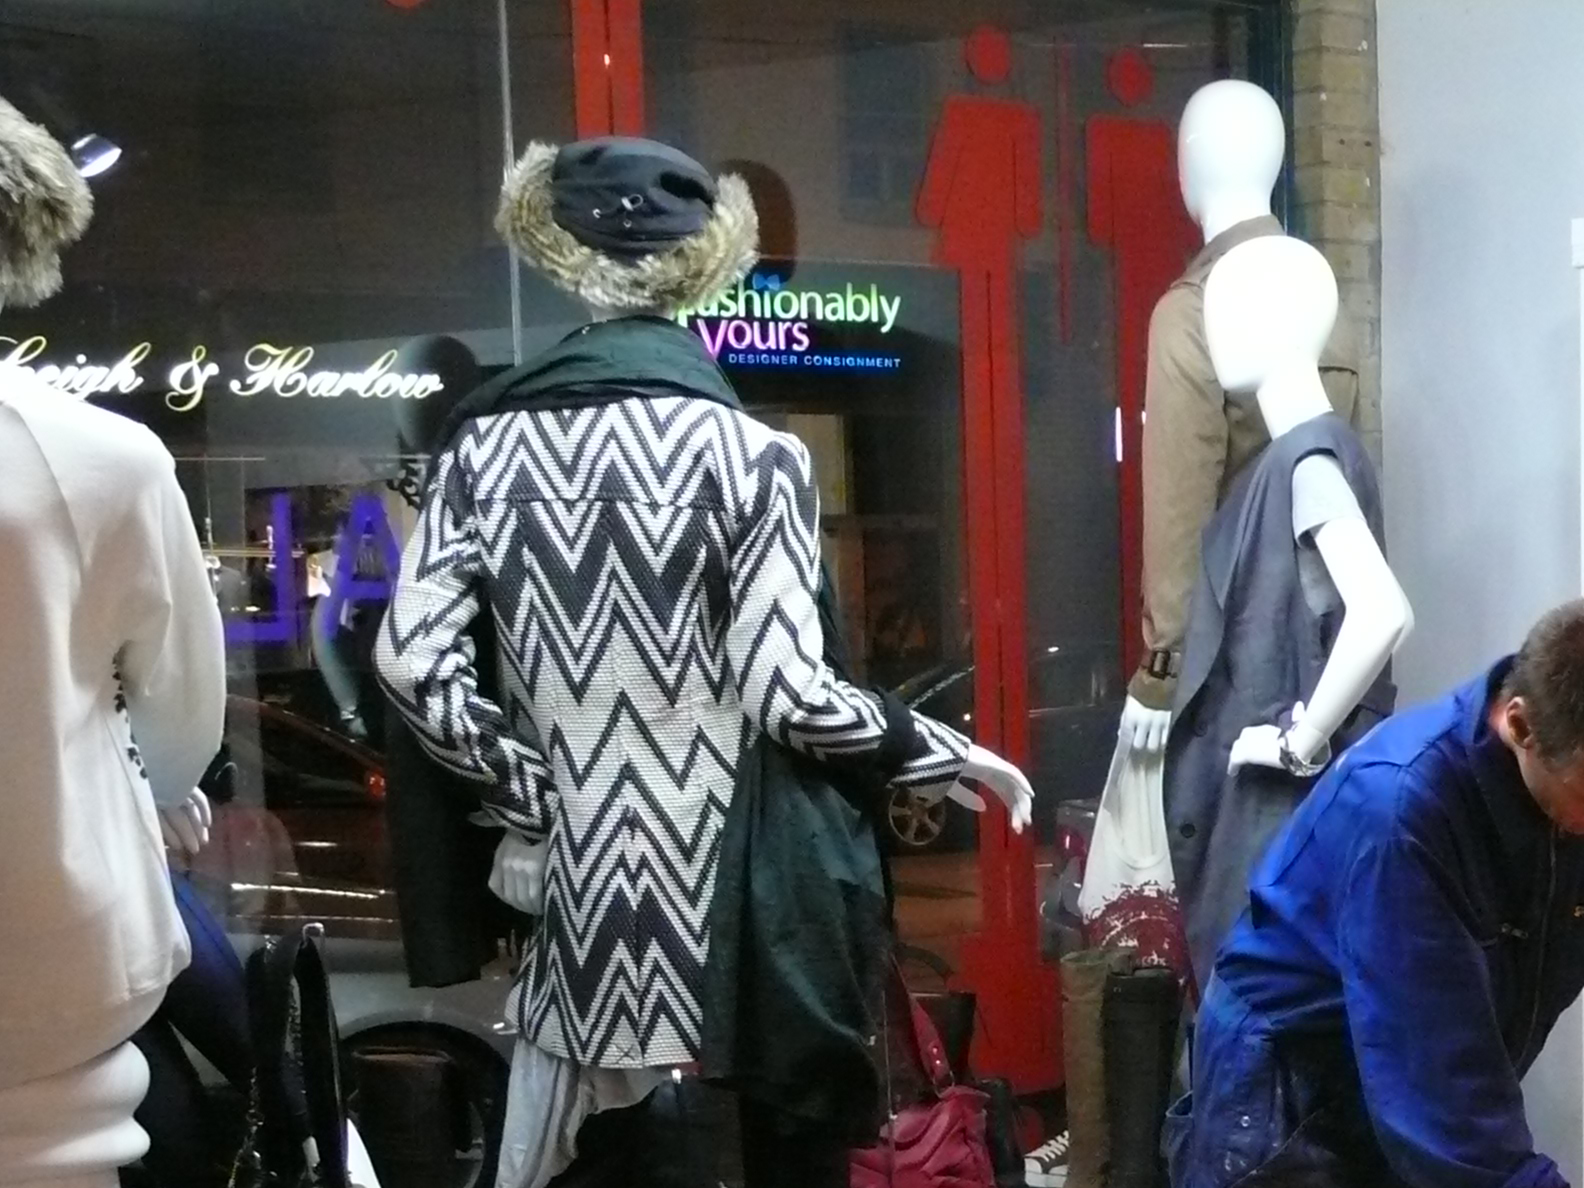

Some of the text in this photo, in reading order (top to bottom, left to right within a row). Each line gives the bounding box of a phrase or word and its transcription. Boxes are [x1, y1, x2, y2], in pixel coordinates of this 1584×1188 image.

[676, 283, 901, 333] ashionably
[165, 345, 219, 411] &
[230, 342, 445, 398] Harlow
[729, 353, 901, 368] DESIGNER CONSIGNMENT
